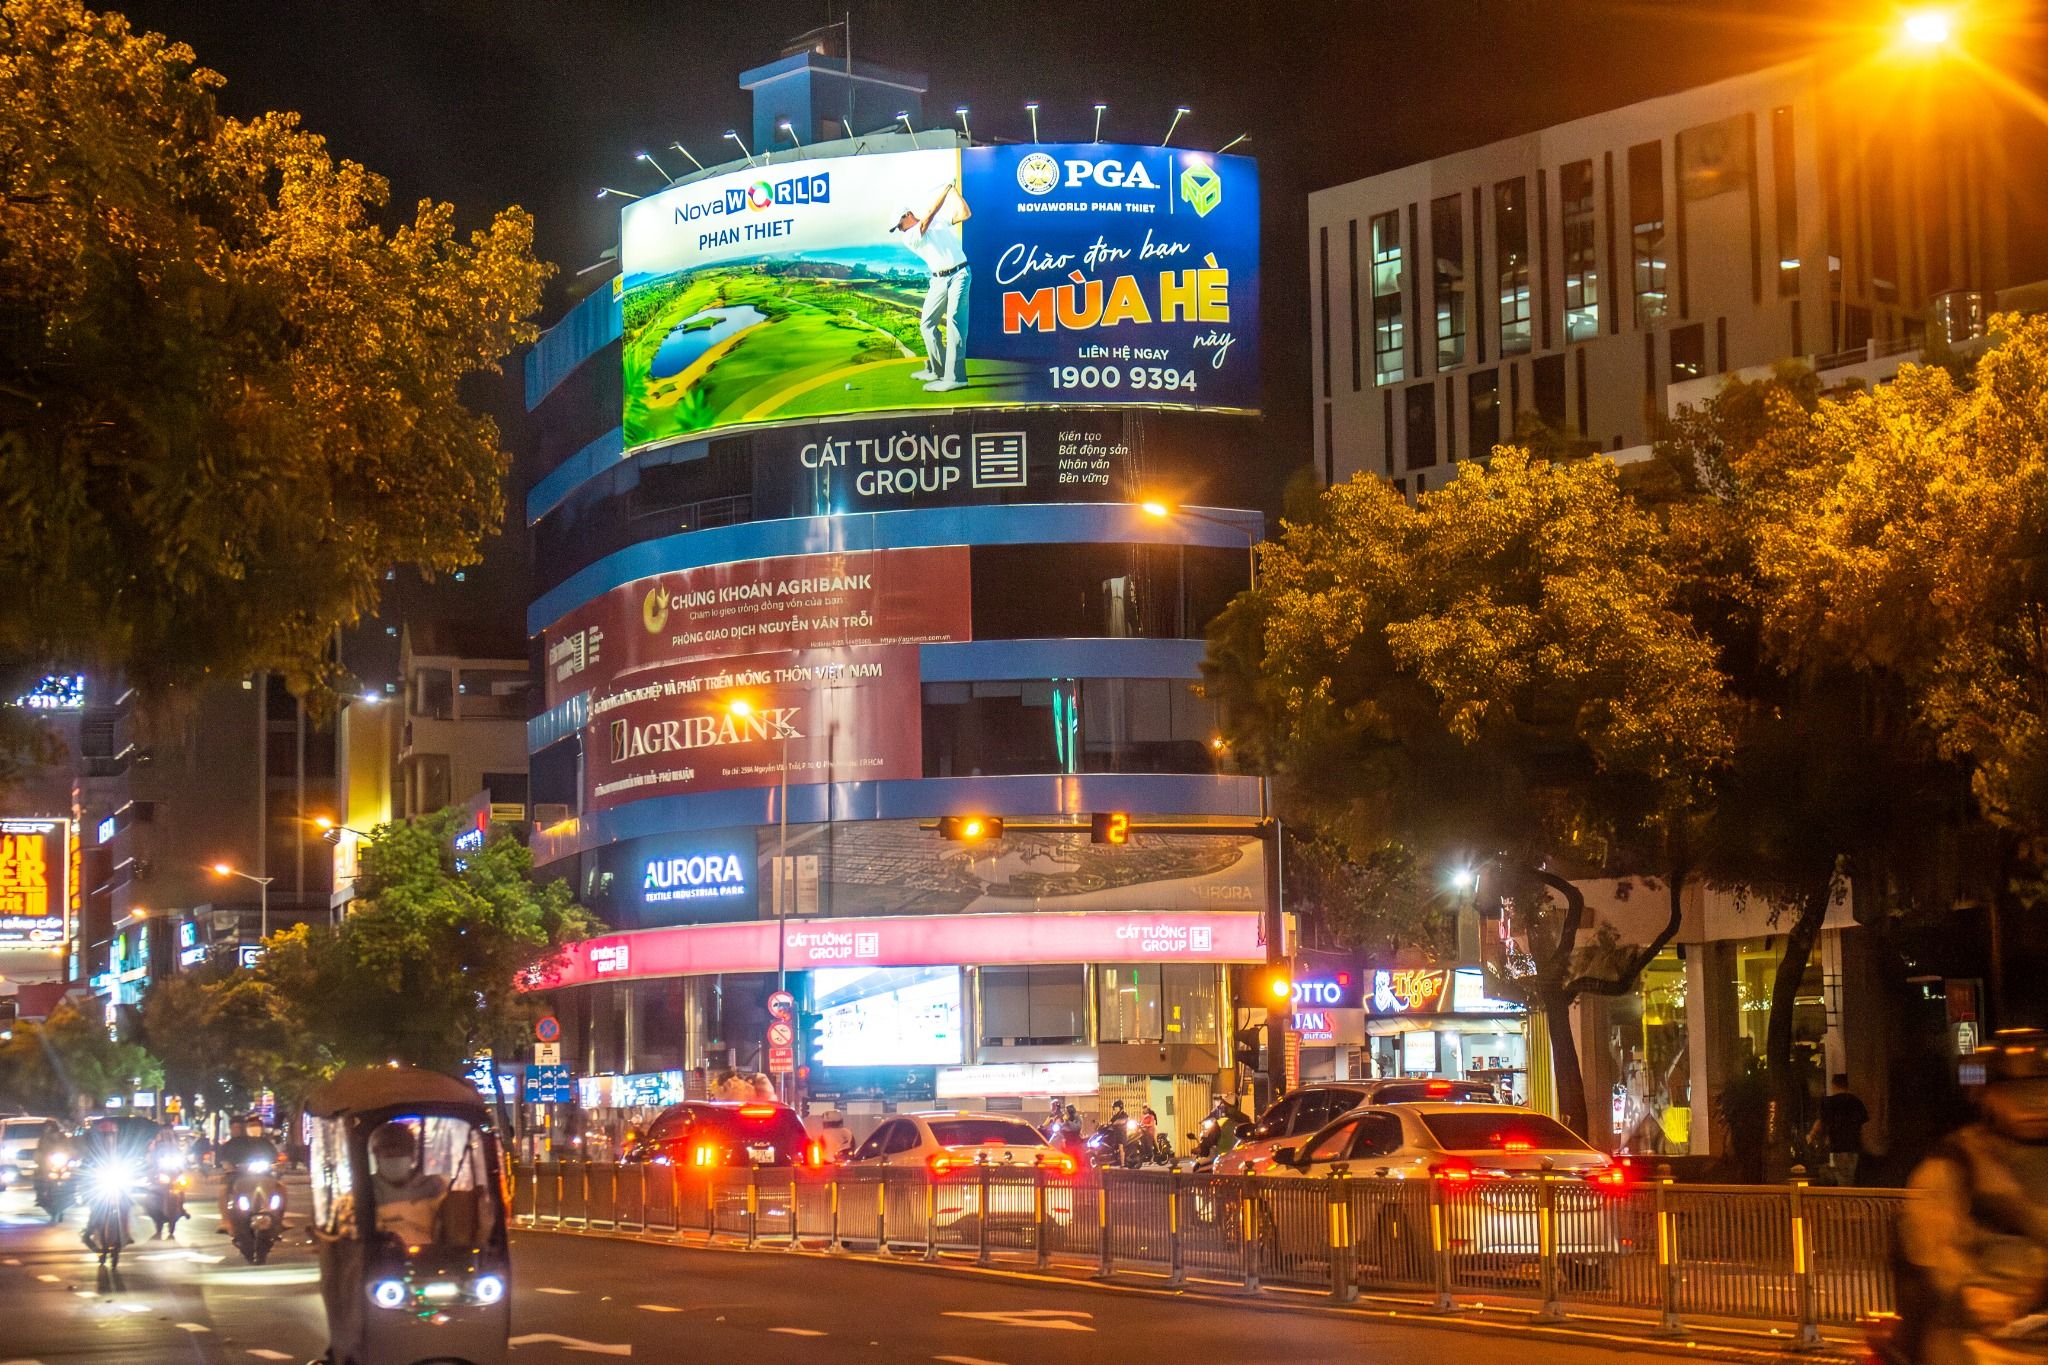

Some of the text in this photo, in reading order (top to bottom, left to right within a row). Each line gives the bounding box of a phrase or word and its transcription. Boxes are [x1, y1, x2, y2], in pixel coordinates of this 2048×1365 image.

[1017, 202, 1155, 214] NOVAWORLD PHAN THIET
[699, 219, 794, 250] PHAN THIET
[995, 228, 1191, 284] Chào đón bạn
[1002, 252, 1230, 334] MÙA HÈ
[1078, 345, 1169, 361] LIÊN HỆ NGAY
[1192, 329, 1236, 369] này
[1049, 366, 1198, 392] 1900 9394
[800, 430, 961, 468] CÁT TƯỜNG
[1058, 430, 1081, 442] Kiến
[1058, 444, 1078, 455] Bất
[1079, 444, 1107, 457] động
[1058, 458, 1088, 470] Nhân
[1058, 471, 1079, 483] Bền
[856, 466, 960, 496] GROUP
[719, 578, 773, 603] KHOÁN
[776, 574, 872, 597] AGRIBANK
[671, 631, 704, 647] PHÒNG
[705, 628, 729, 641] GIAO
[730, 625, 756, 640] DỊCH
[735, 670, 771, 687] NÔNG
[774, 664, 812, 683] THÔN
[849, 663, 883, 678] NAM
[629, 707, 806, 758] AGRIBANK
[1110, 813, 1127, 842] 2
[644, 854, 744, 889] AURORA
[673, 886, 719, 899] INDUSTRIAL
[719, 885, 745, 896] PARK
[809, 946, 853, 959] GROUP
[1142, 940, 1187, 952] GROUP
[1392, 970, 1443, 1009] Tiger
